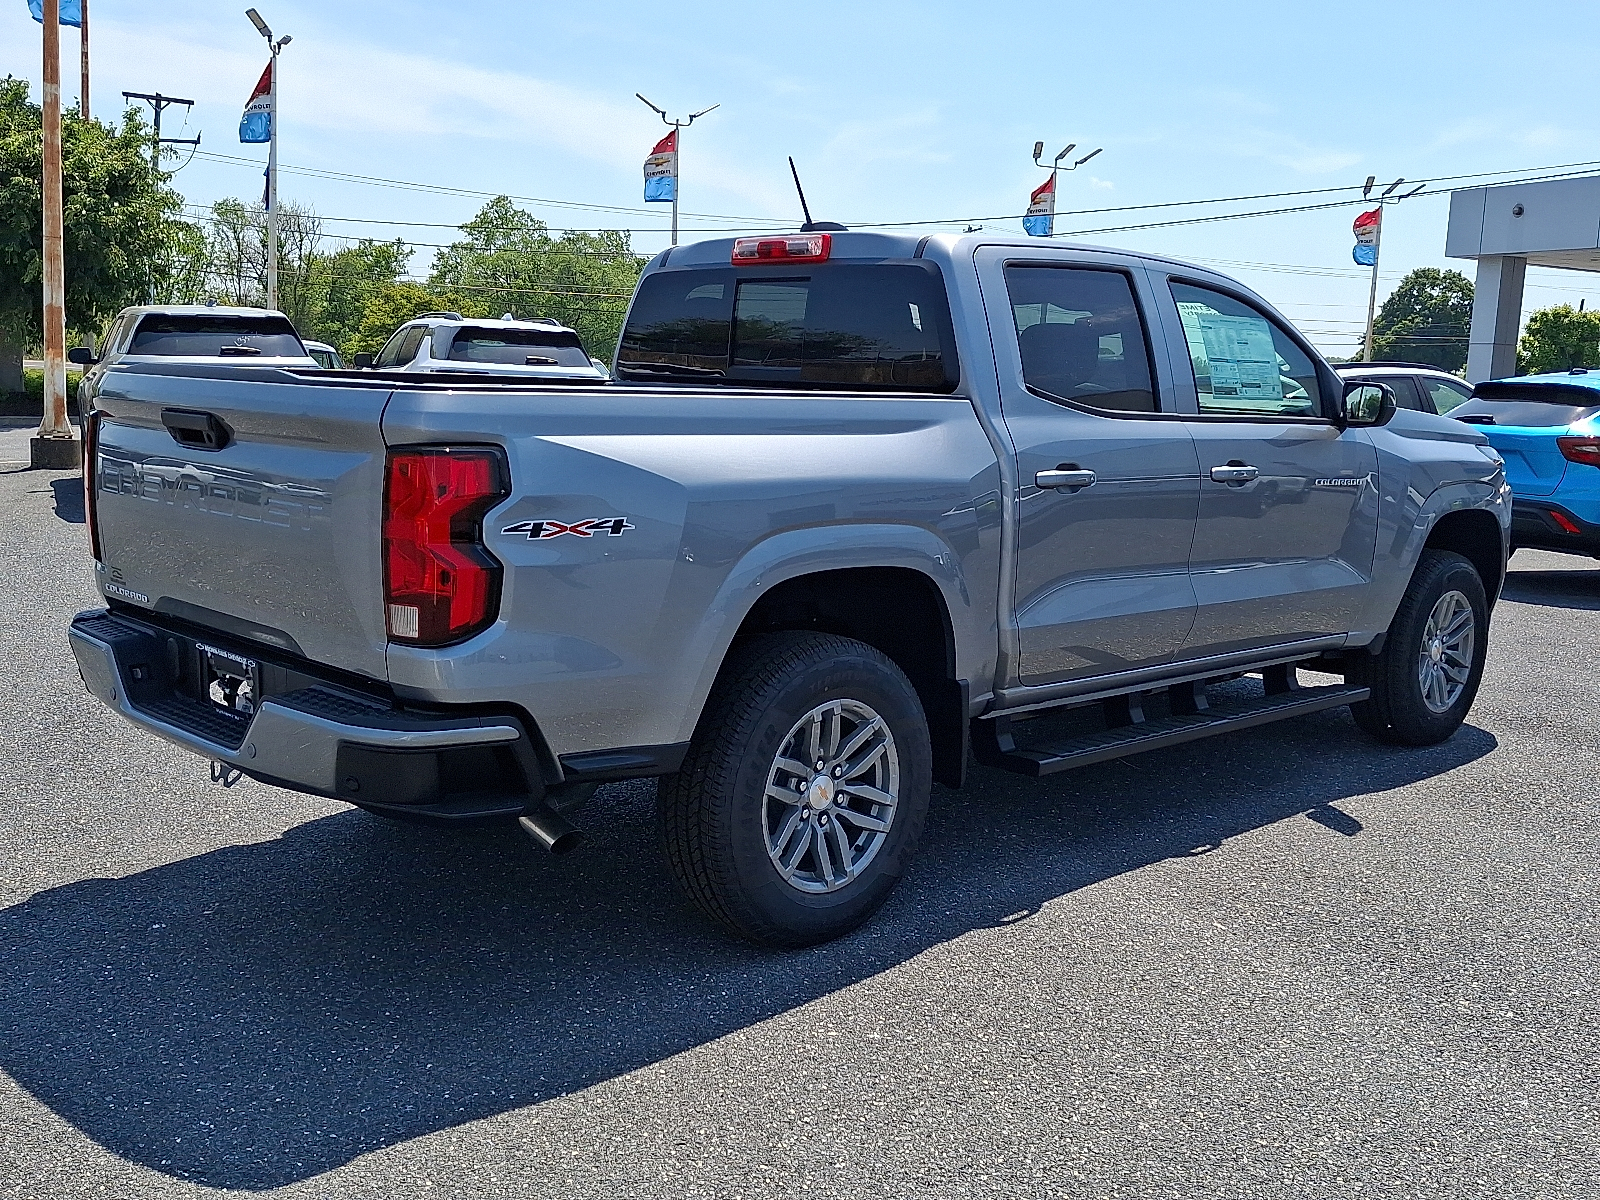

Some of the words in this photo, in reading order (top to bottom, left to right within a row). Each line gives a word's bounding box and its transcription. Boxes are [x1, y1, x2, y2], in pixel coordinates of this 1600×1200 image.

[1315, 478, 1363, 486] COLORADO
[101, 460, 324, 531] CHEVROLET
[105, 583, 148, 603] COLORADO
